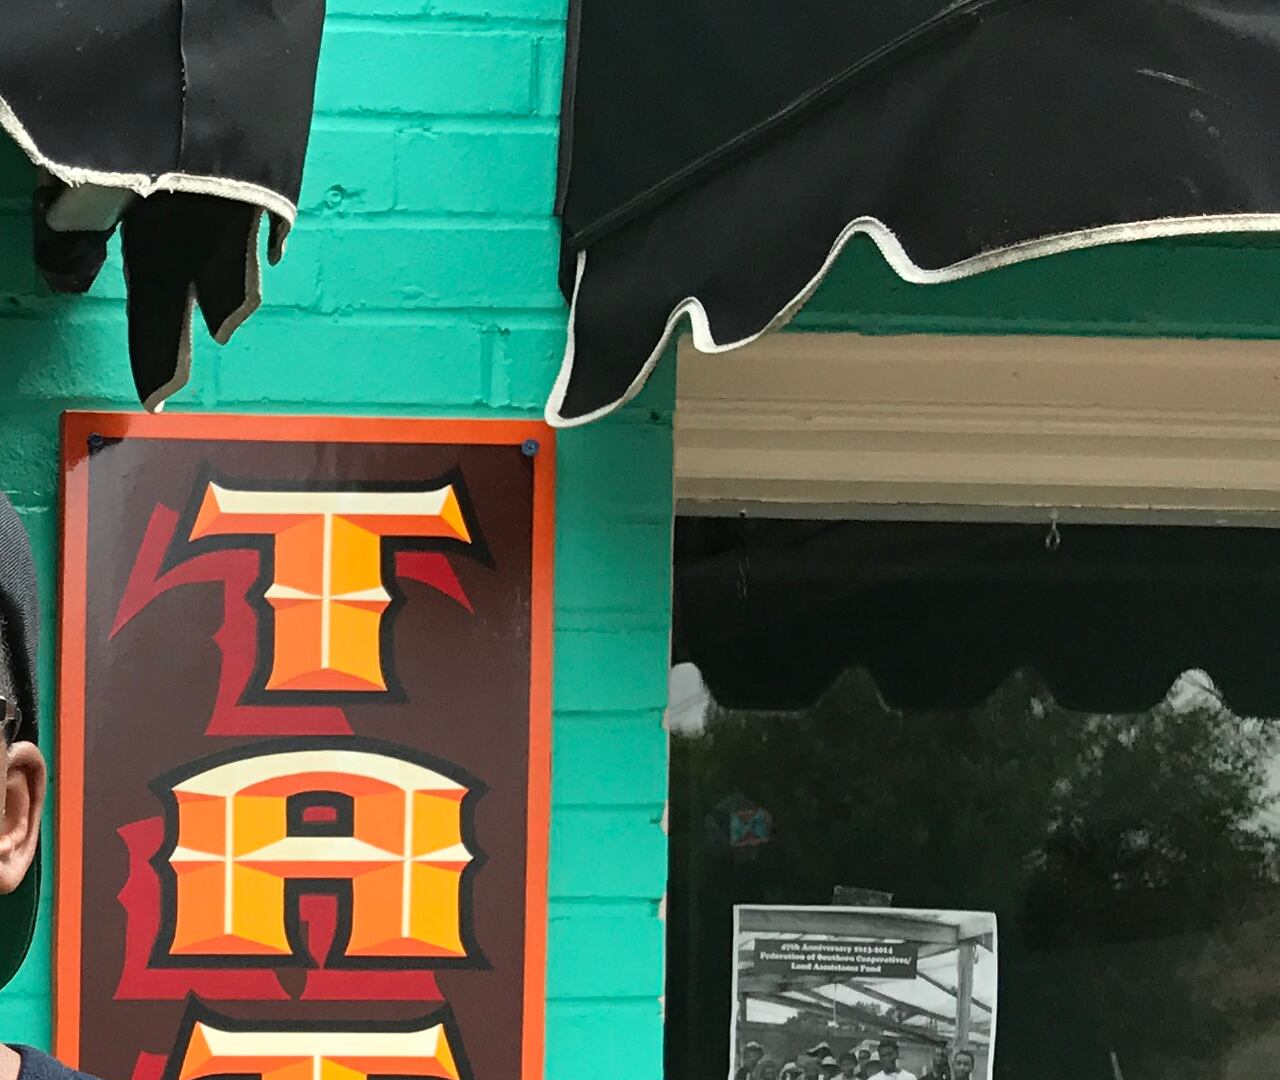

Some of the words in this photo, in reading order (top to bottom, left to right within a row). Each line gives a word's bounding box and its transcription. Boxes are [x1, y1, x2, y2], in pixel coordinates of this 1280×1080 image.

[801, 943, 852, 953] Anniversary
[760, 951, 806, 960] Federation
[806, 952, 816, 961] of
[817, 953, 855, 962] Southern
[791, 962, 812, 970] Land
[813, 963, 859, 972] Assistance
[860, 964, 882, 973] Fund
